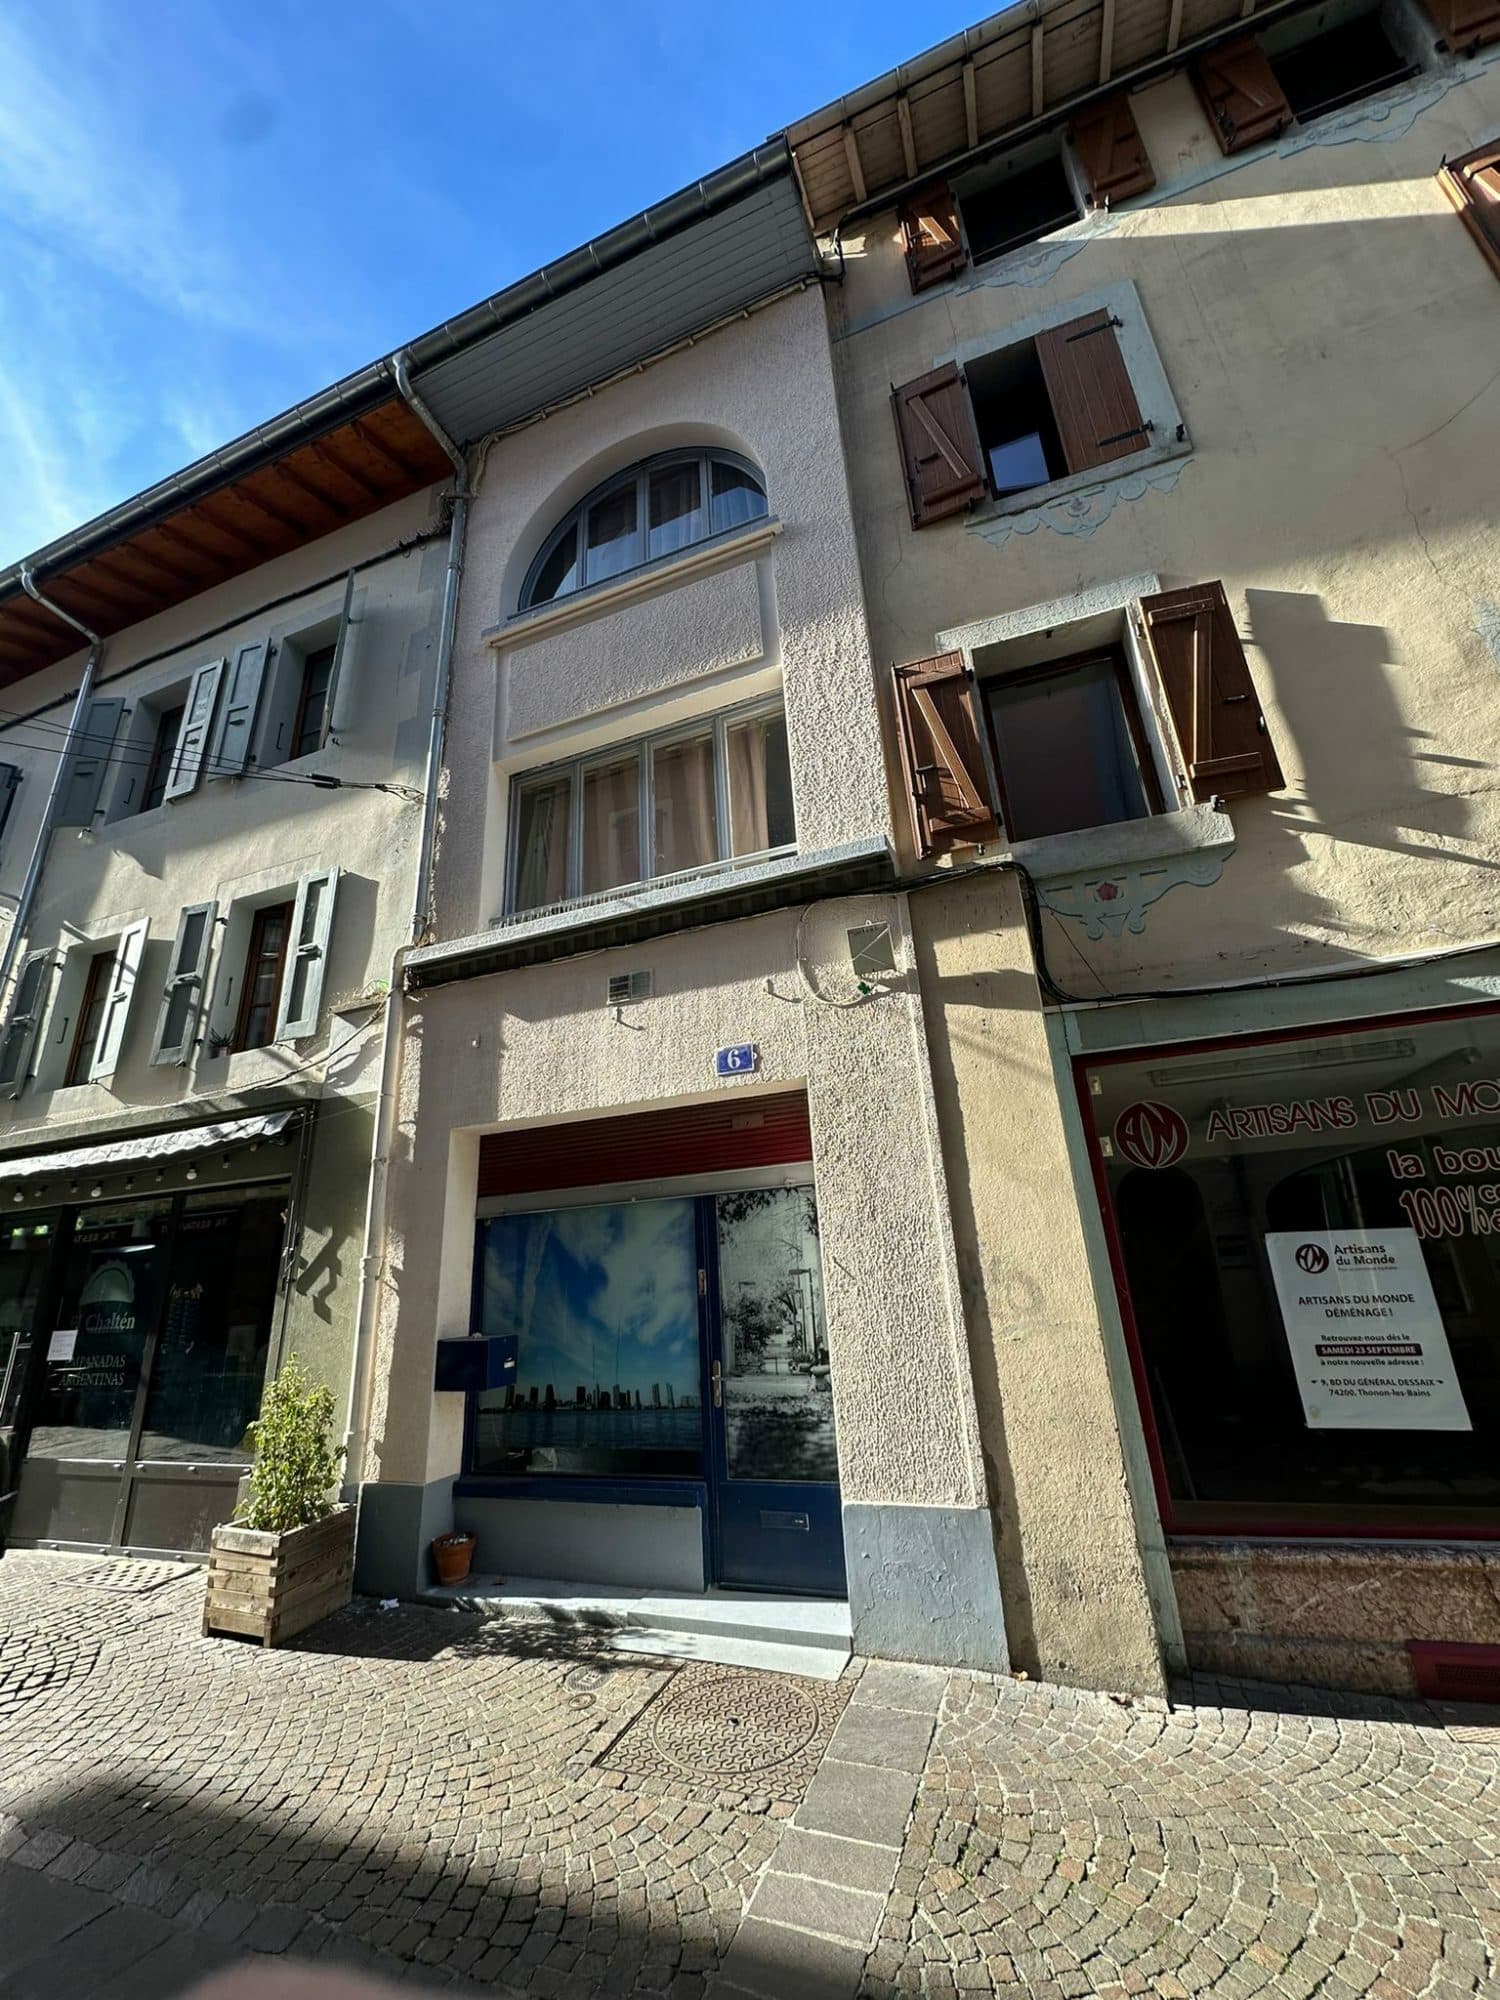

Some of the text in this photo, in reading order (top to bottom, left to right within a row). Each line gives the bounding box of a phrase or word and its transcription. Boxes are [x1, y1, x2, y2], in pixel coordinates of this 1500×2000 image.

[727, 1048, 741, 1070] 6
[1206, 1096, 1359, 1143] ARTISANS
[1364, 1087, 1422, 1126] DU
[1387, 1150, 1426, 1179] la
[1398, 1185, 1492, 1239] 100%
[1334, 1244, 1386, 1255] Artisans
[1336, 1254, 1395, 1266] du Monde
[1298, 1294, 1416, 1305] ARTISANS DU MONDE
[1321, 1346, 1354, 1354] SAMEDI
[1366, 1345, 1417, 1354] SEPTEMBRE
[1350, 1358, 1386, 1366] nouvelle
[1387, 1358, 1419, 1366] adresse
[1343, 1378, 1356, 1386] DU
[1357, 1376, 1397, 1386] GÉNÉRAL
